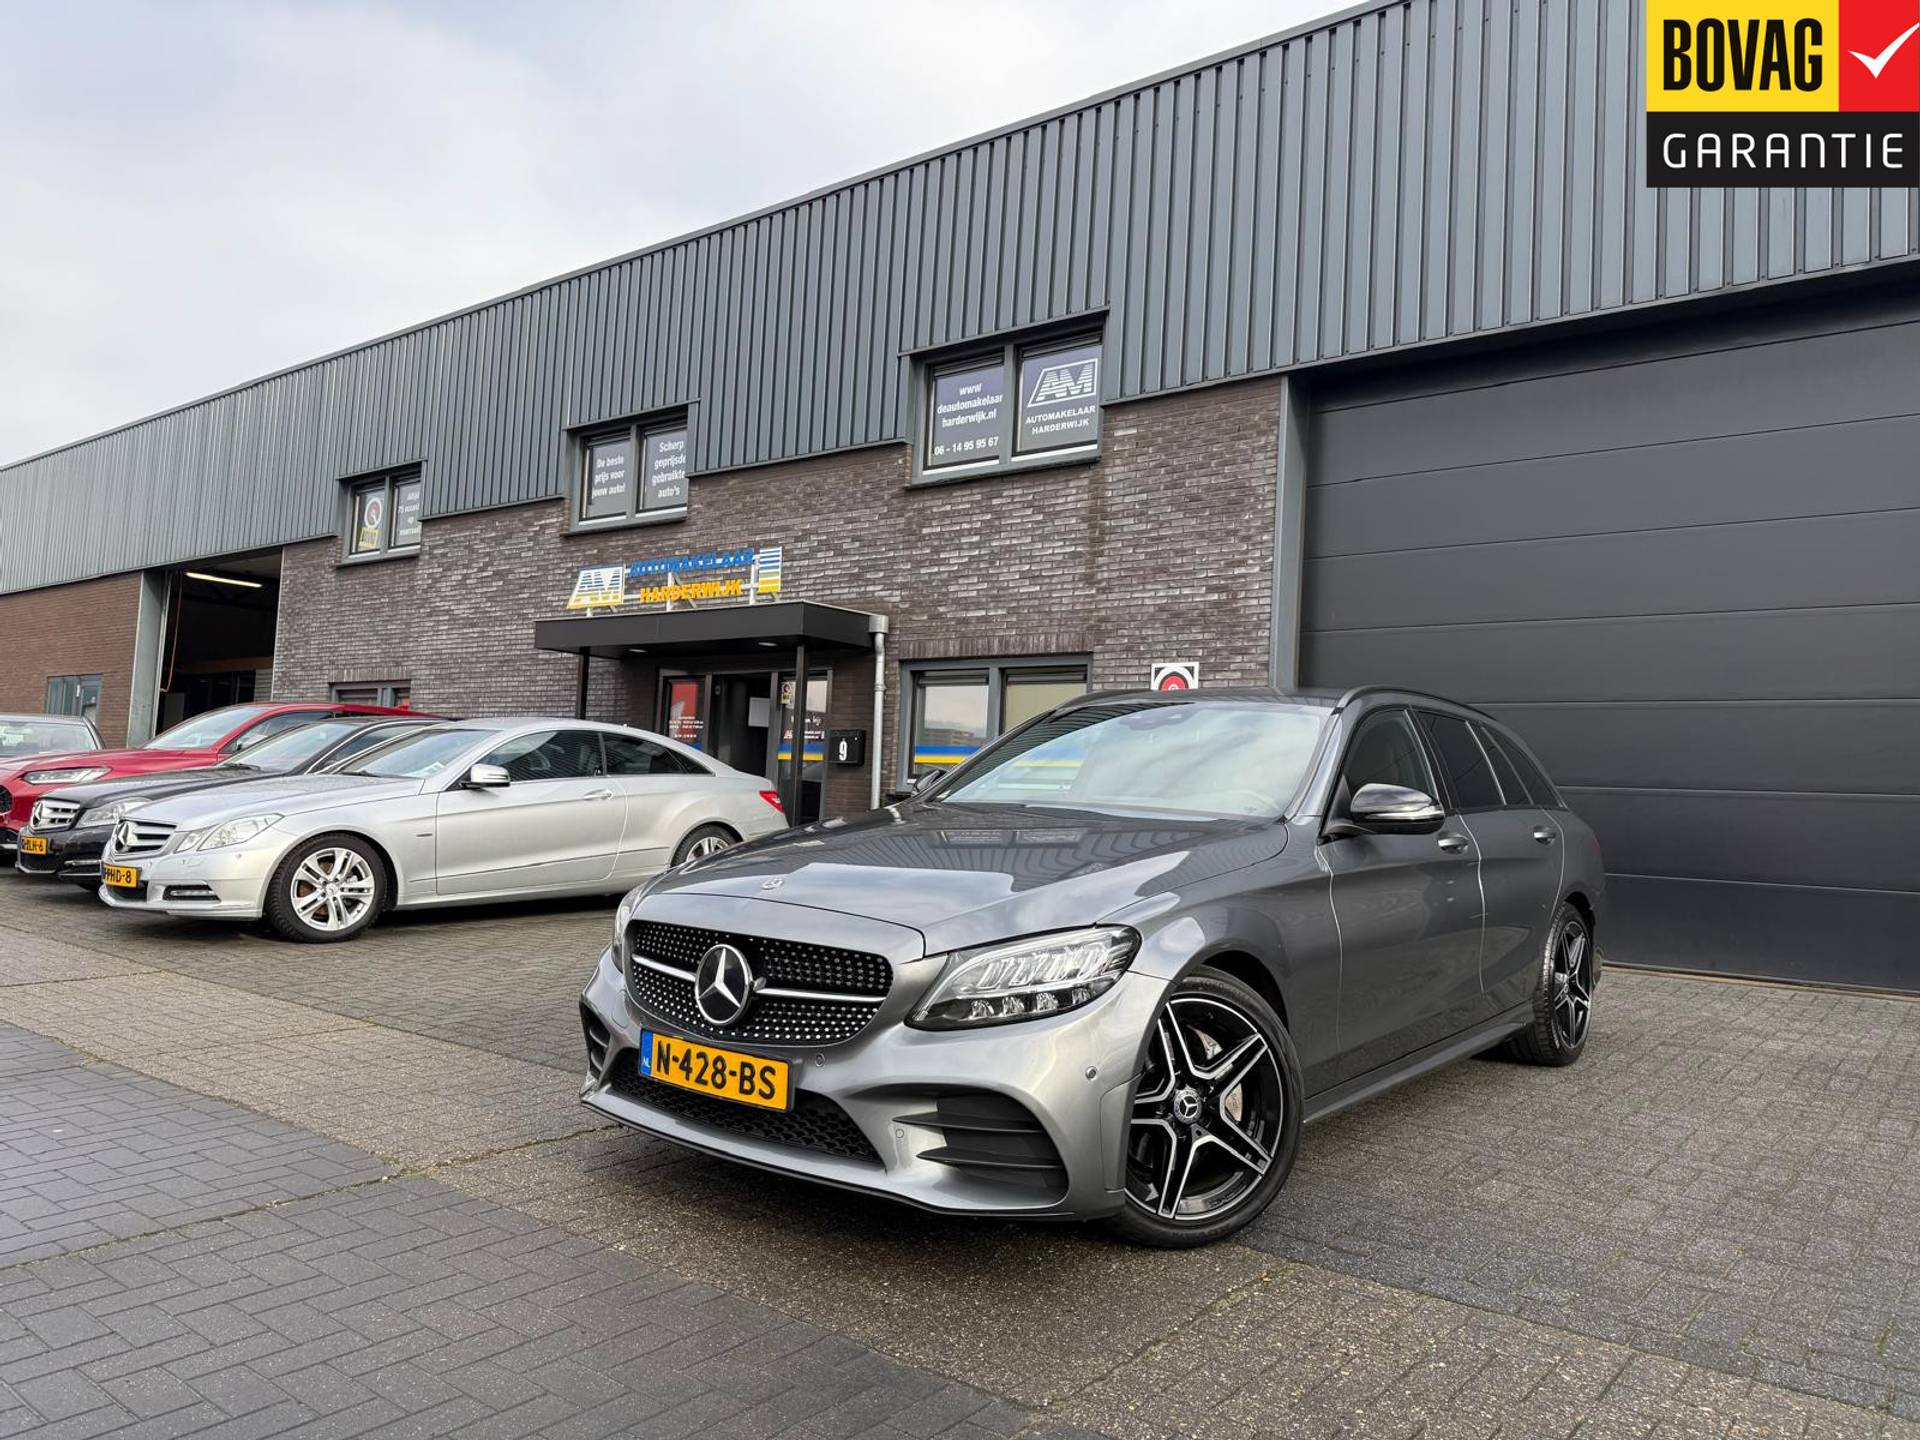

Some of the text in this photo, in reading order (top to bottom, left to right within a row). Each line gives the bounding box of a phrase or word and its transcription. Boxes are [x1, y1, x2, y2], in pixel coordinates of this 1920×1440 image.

[959, 383, 982, 396] www
[937, 394, 1003, 415] deautomakelaar
[942, 408, 997, 428] harderwijk.nl
[1025, 405, 1096, 425] AUTOMAKELAAR
[1031, 419, 1090, 435] HARDERWIJK
[660, 441, 684, 452] Scherp
[934, 445, 945, 455] 06
[952, 442, 962, 453] 14
[964, 440, 974, 451] 95
[975, 438, 986, 449] 95
[988, 437, 999, 447] 67
[629, 548, 754, 577] AUTOMAKELAAR
[640, 579, 742, 602] HARDERWIJK
[838, 739, 848, 761] 9
[656, 1040, 777, 1100] N-428-BS
